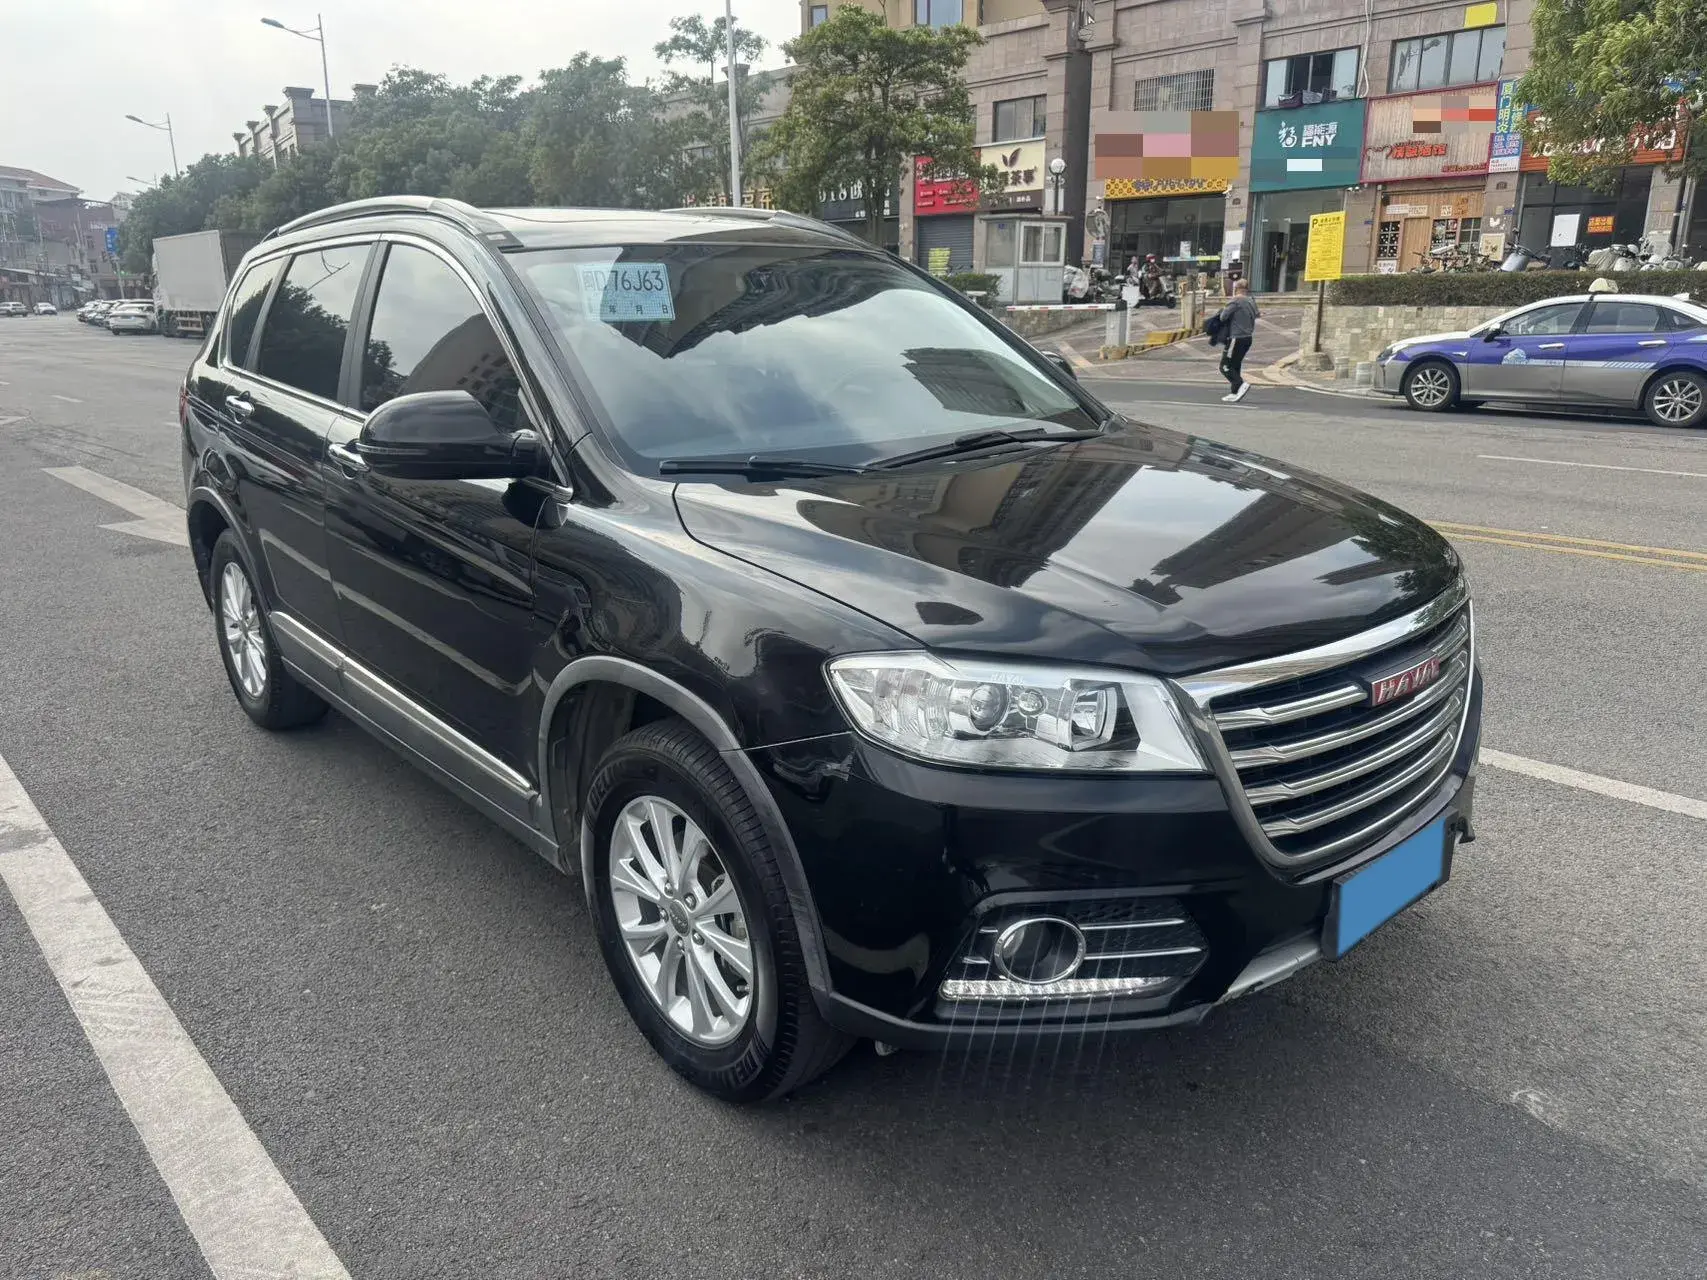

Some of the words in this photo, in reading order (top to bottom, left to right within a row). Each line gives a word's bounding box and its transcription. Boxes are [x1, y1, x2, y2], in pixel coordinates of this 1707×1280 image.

[1301, 134, 1336, 148] FNY
[1312, 218, 1319, 229] P
[1377, 659, 1440, 703] HAVAL
